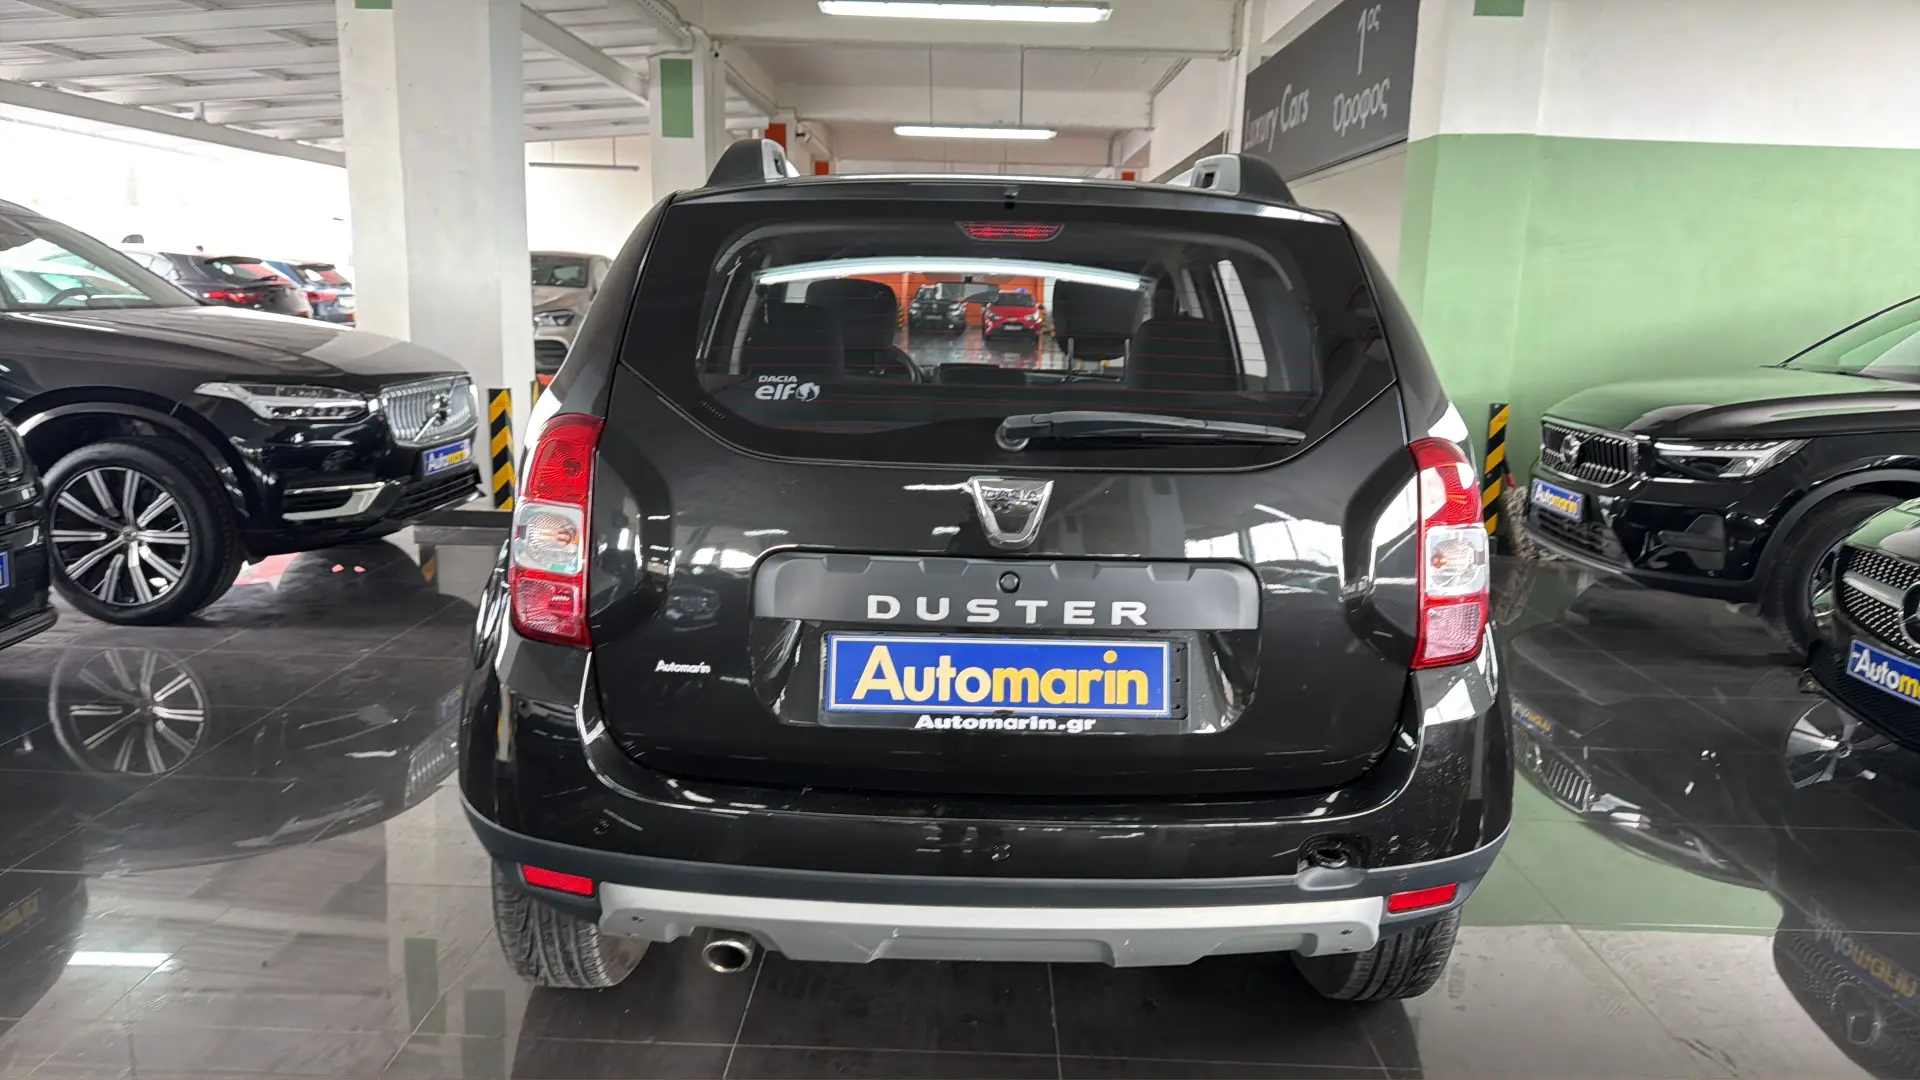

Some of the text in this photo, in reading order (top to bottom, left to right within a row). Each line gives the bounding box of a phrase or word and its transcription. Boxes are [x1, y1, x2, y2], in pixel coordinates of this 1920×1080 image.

[1280, 83, 1310, 133] Cars
[754, 383, 798, 401] elf
[758, 375, 798, 383] DACIA
[866, 594, 1148, 626] DUSTER
[654, 659, 711, 674] Automarin
[851, 644, 1149, 706] Automarin
[1853, 648, 1920, 699] Autom
[914, 714, 1097, 734] Automarin.gr
